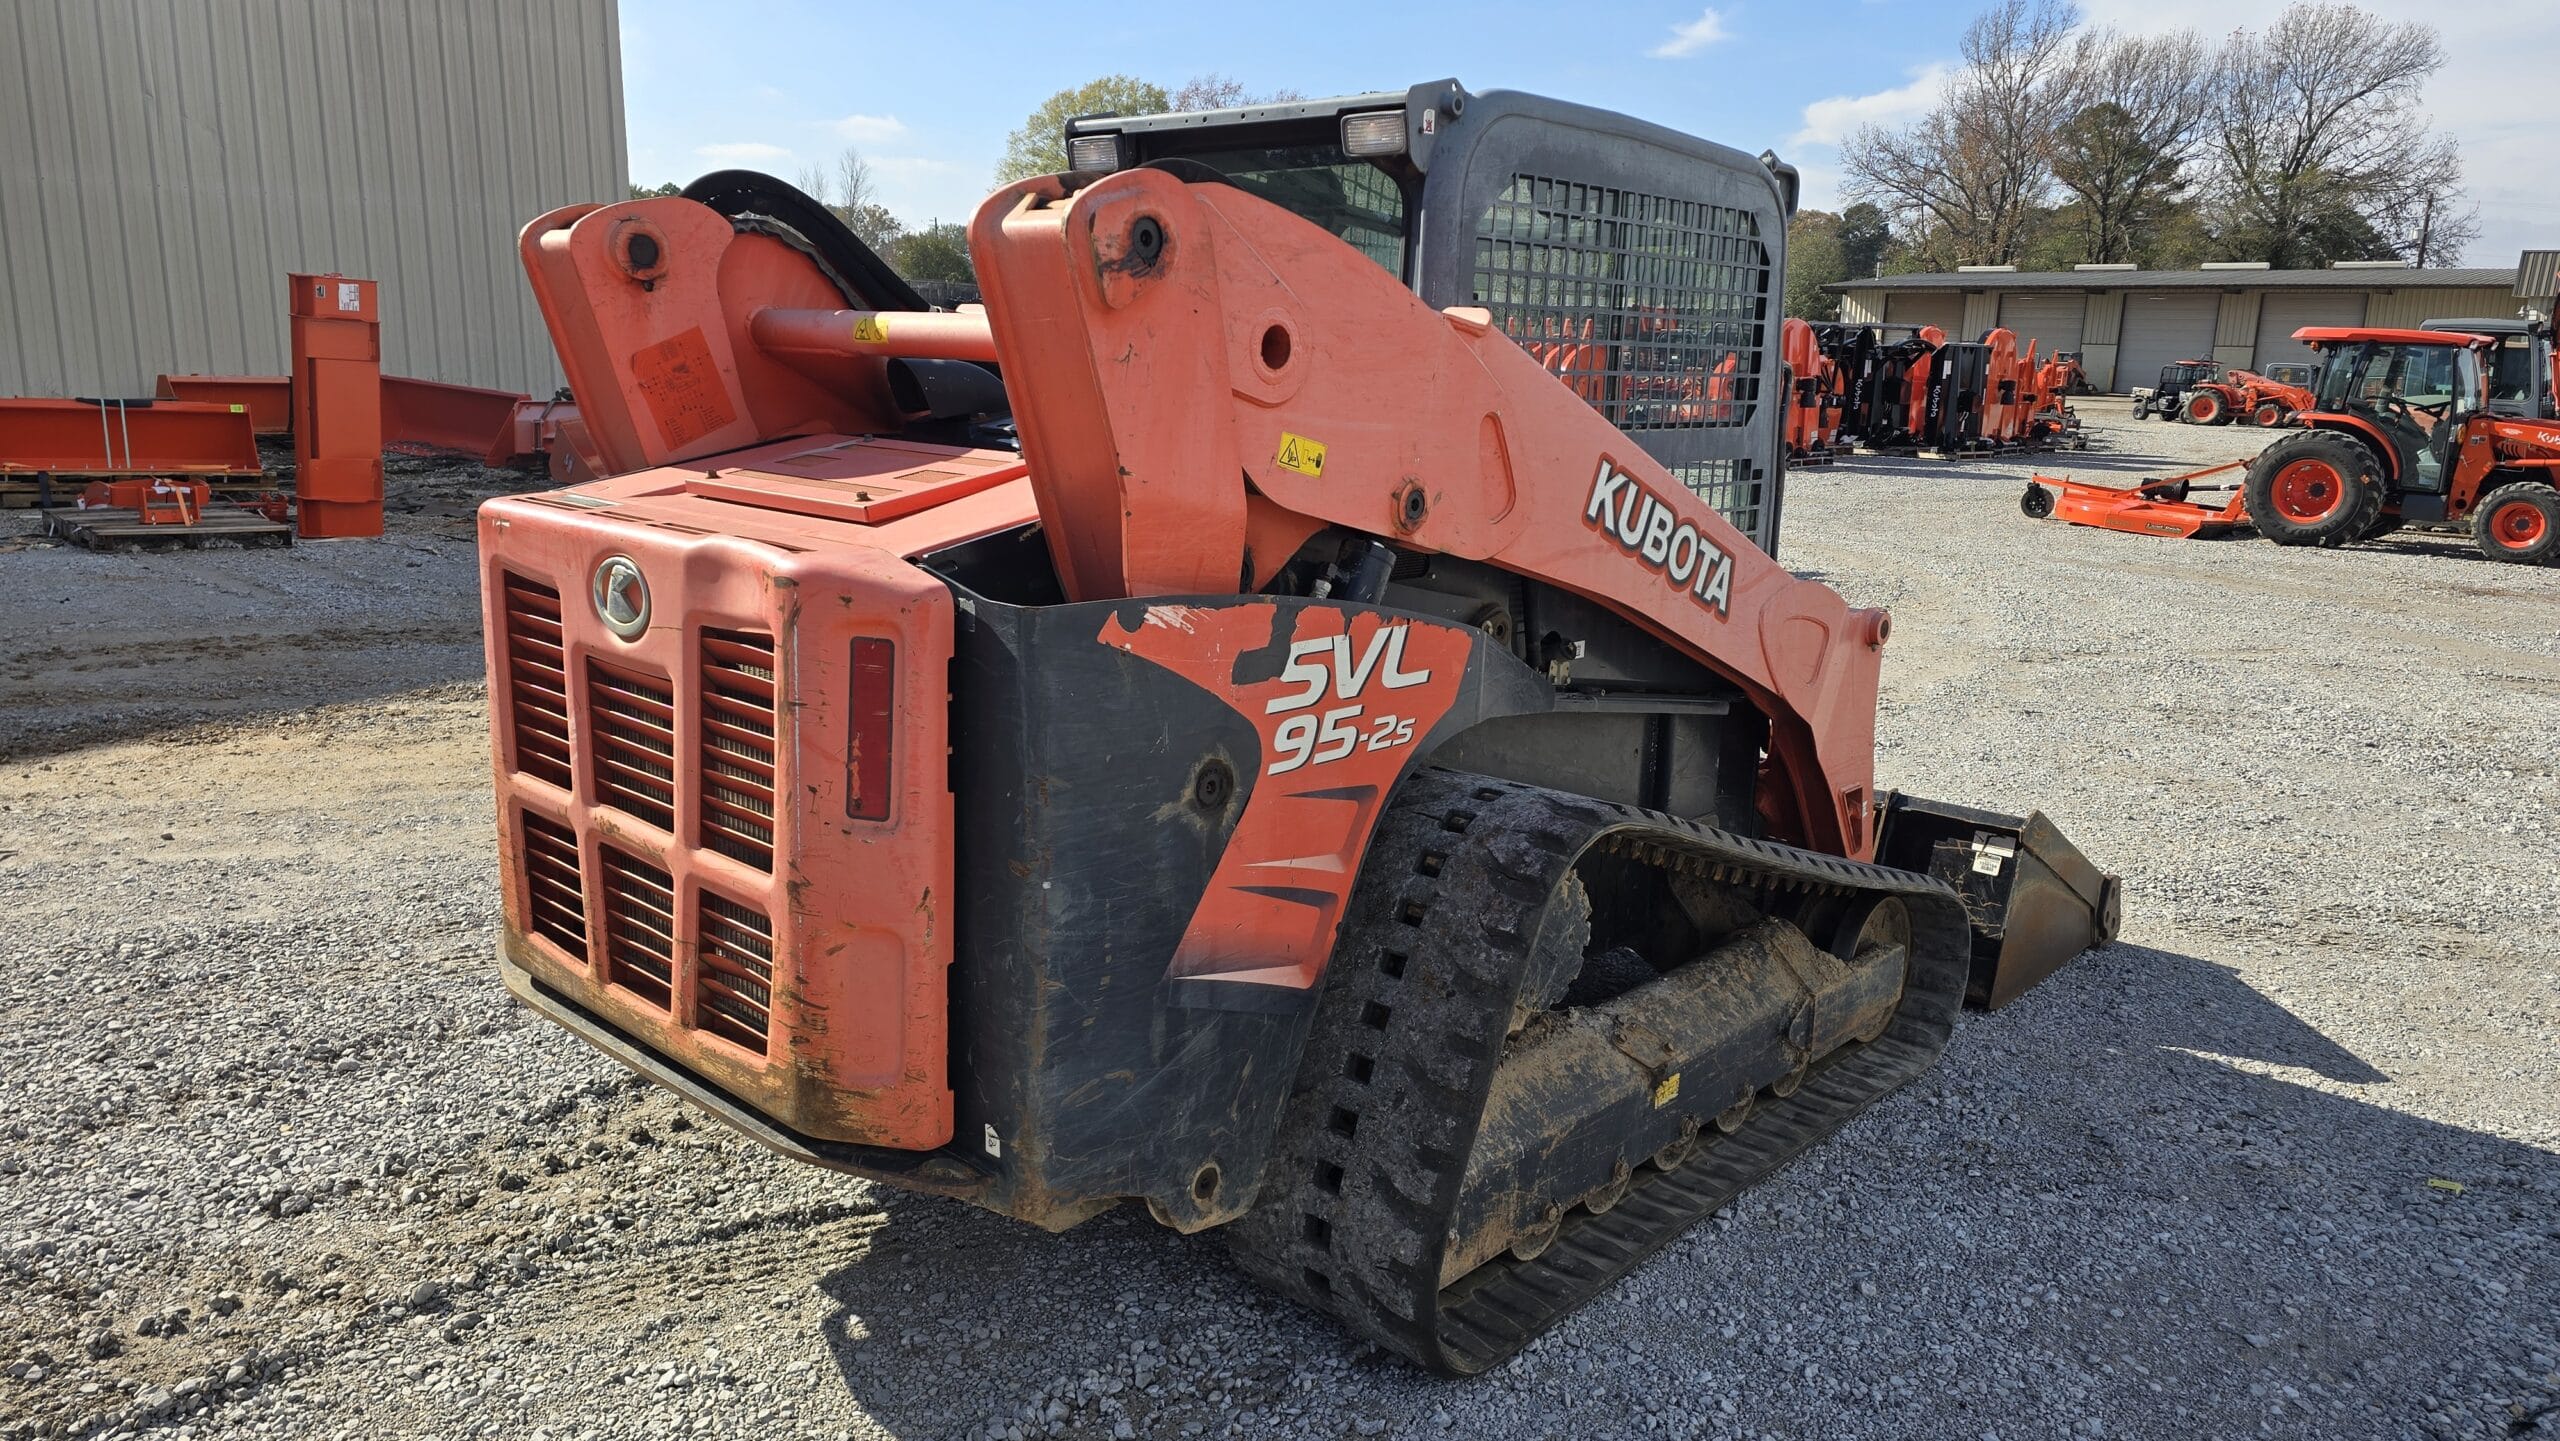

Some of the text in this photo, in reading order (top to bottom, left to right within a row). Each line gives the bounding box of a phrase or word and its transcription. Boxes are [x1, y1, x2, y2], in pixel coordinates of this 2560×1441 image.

[1853, 379, 1863, 410] Kubota
[1930, 385, 1942, 418] Kubota
[1586, 459, 1733, 614] KUBOTA
[1265, 624, 1431, 715] SVL
